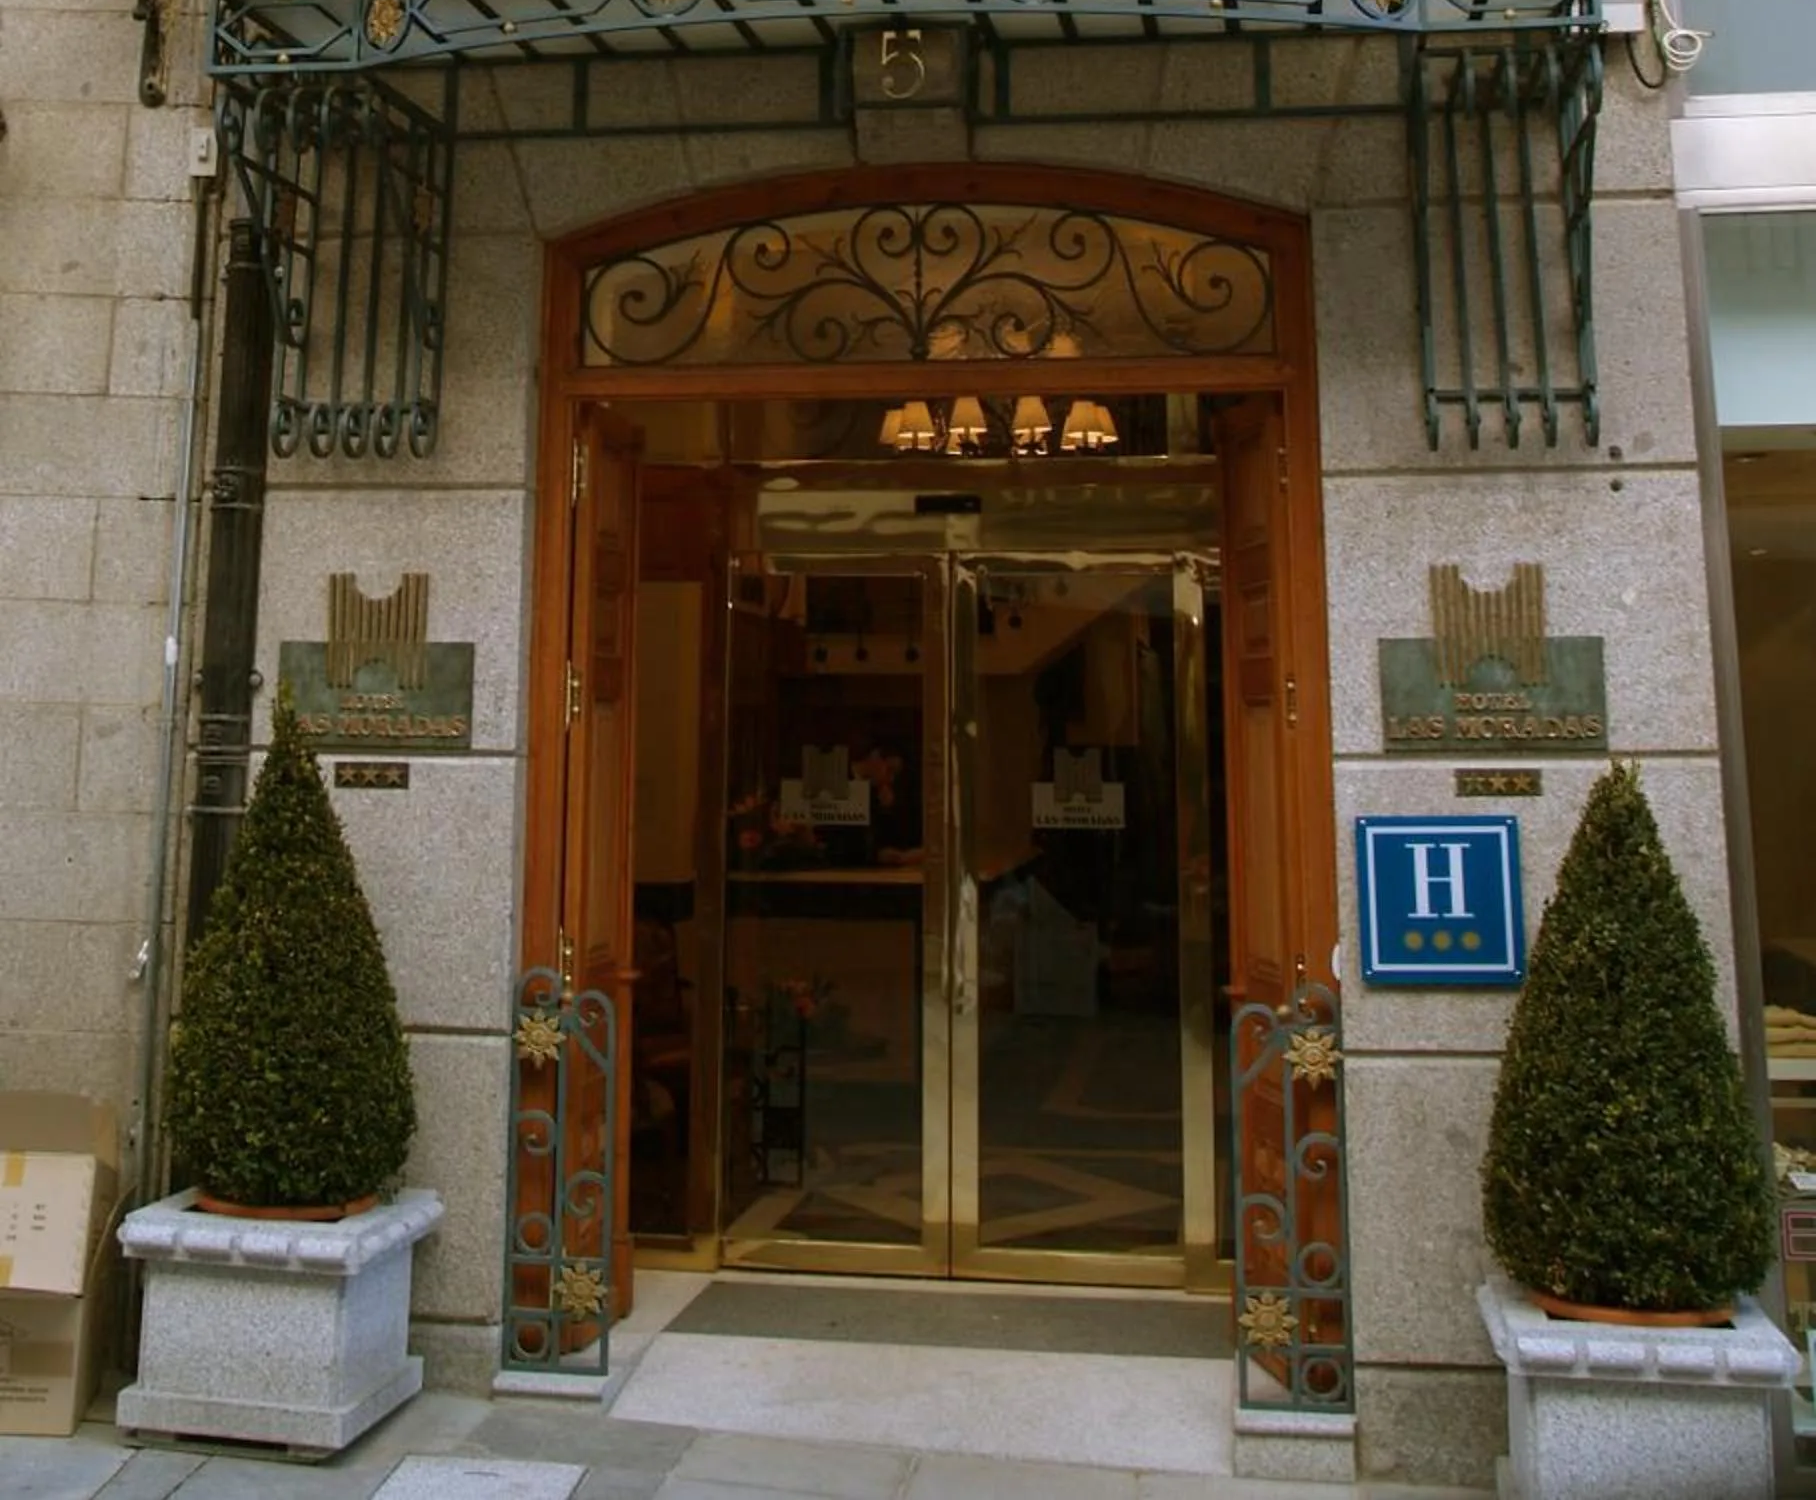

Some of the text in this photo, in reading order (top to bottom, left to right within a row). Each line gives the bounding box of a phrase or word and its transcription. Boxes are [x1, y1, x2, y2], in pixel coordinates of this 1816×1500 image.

[881, 30, 926, 99] 5
[1453, 693, 1532, 712] HOTEL
[296, 712, 467, 738] AS MORADAS
[1387, 715, 1602, 741] LAS MORADAS
[1404, 842, 1475, 919] H
